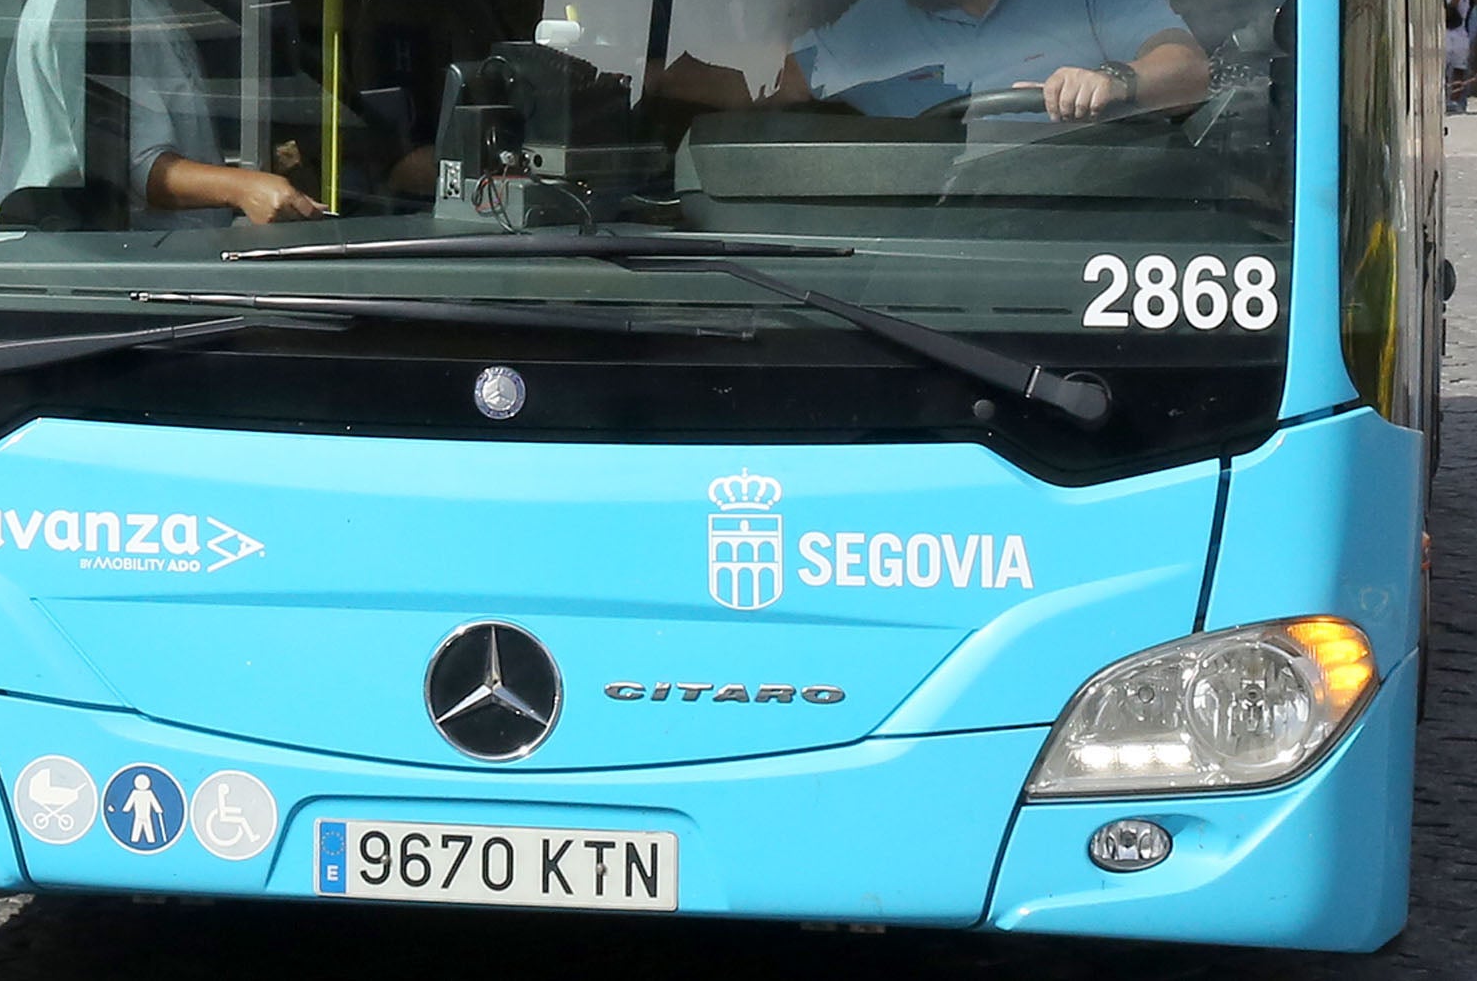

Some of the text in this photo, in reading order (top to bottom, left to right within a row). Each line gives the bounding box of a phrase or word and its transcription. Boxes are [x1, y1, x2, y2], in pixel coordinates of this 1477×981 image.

[1081, 253, 1280, 331] 2868
[79, 556, 202, 573] BY MOBILITY ADO
[796, 531, 1035, 590] SEGOVIA
[603, 680, 847, 705] CITARO
[326, 830, 659, 899] E 9670 KTN
